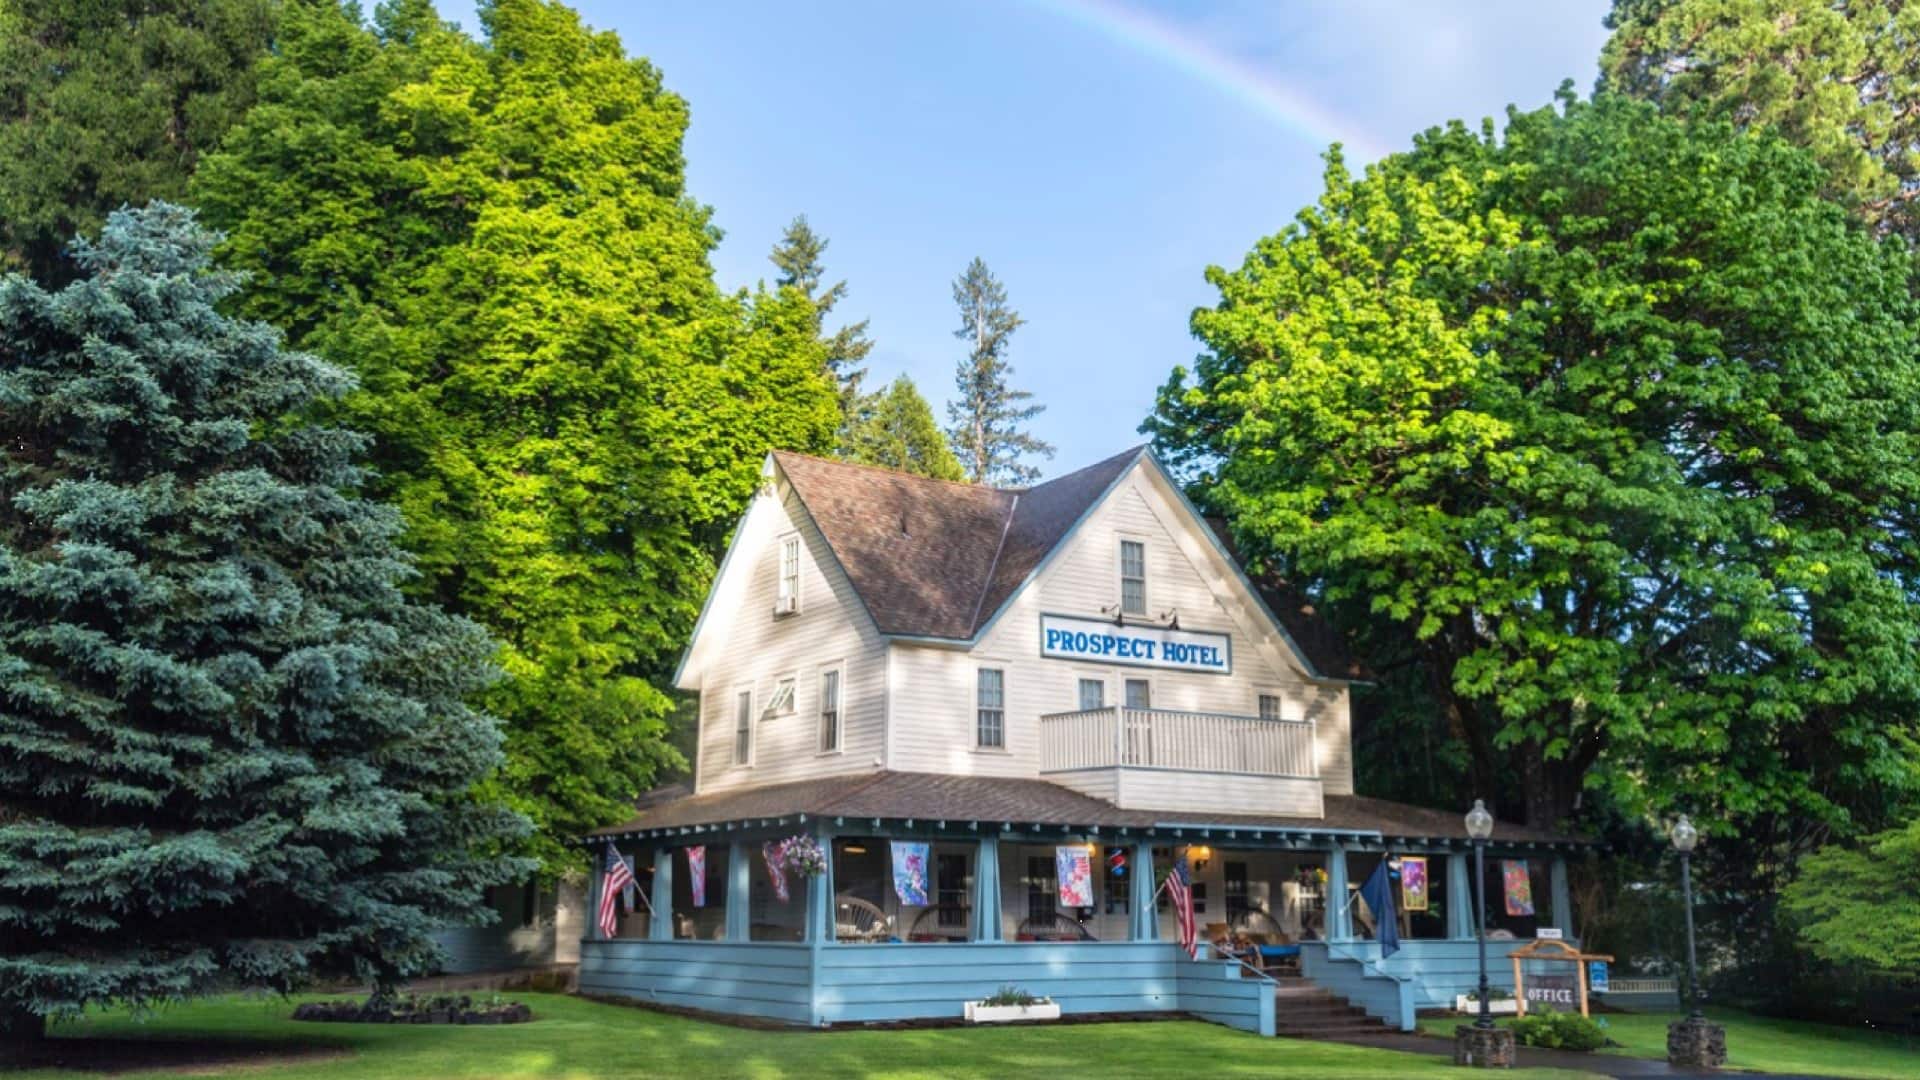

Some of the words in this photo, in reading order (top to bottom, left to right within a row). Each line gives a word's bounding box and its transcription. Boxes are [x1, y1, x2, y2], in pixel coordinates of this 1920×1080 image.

[1047, 629, 1155, 659] PROSPECT
[1163, 642, 1223, 666] HOTEL
[1528, 989, 1572, 1002] OFFICE
